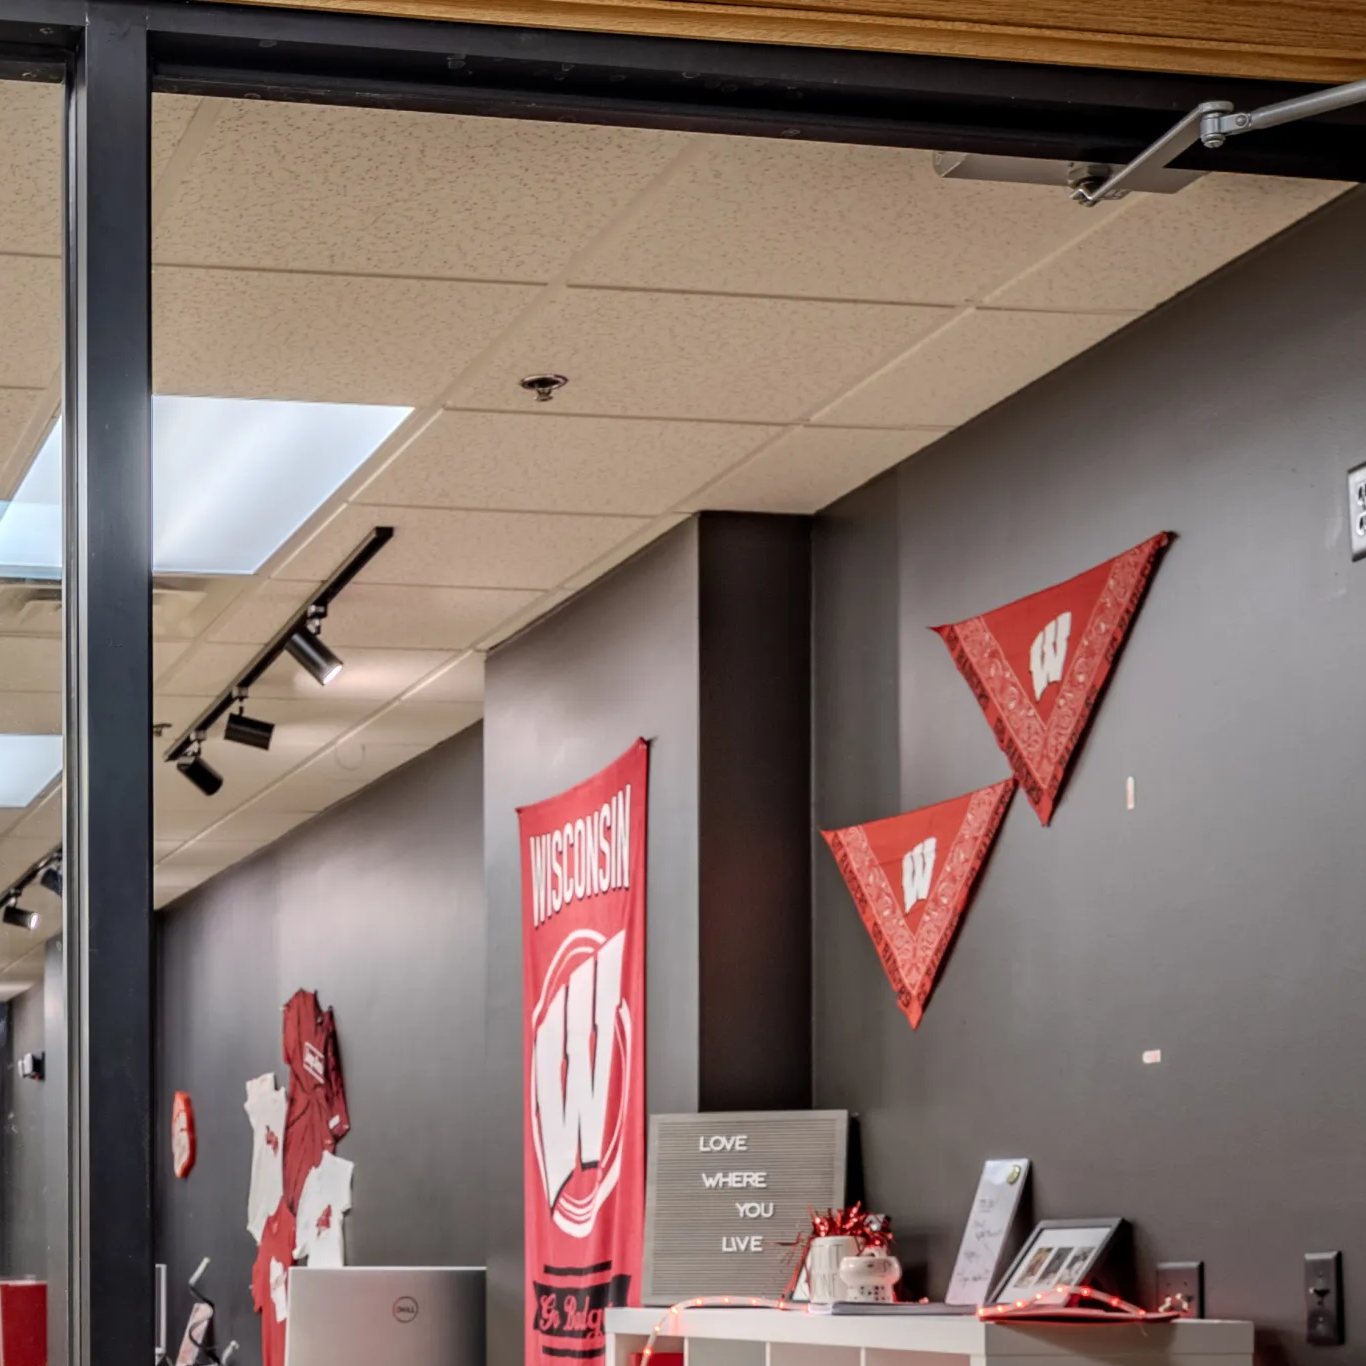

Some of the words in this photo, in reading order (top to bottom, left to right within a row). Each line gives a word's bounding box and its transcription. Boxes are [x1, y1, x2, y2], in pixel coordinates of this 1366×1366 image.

[529, 784, 632, 930] WISCONSIN
[699, 1136, 748, 1151] LOVE
[701, 1172, 767, 1188] WHERE
[735, 1203, 774, 1218] YOU
[722, 1236, 763, 1252] LIVE
[564, 1294, 606, 1341] Badg
